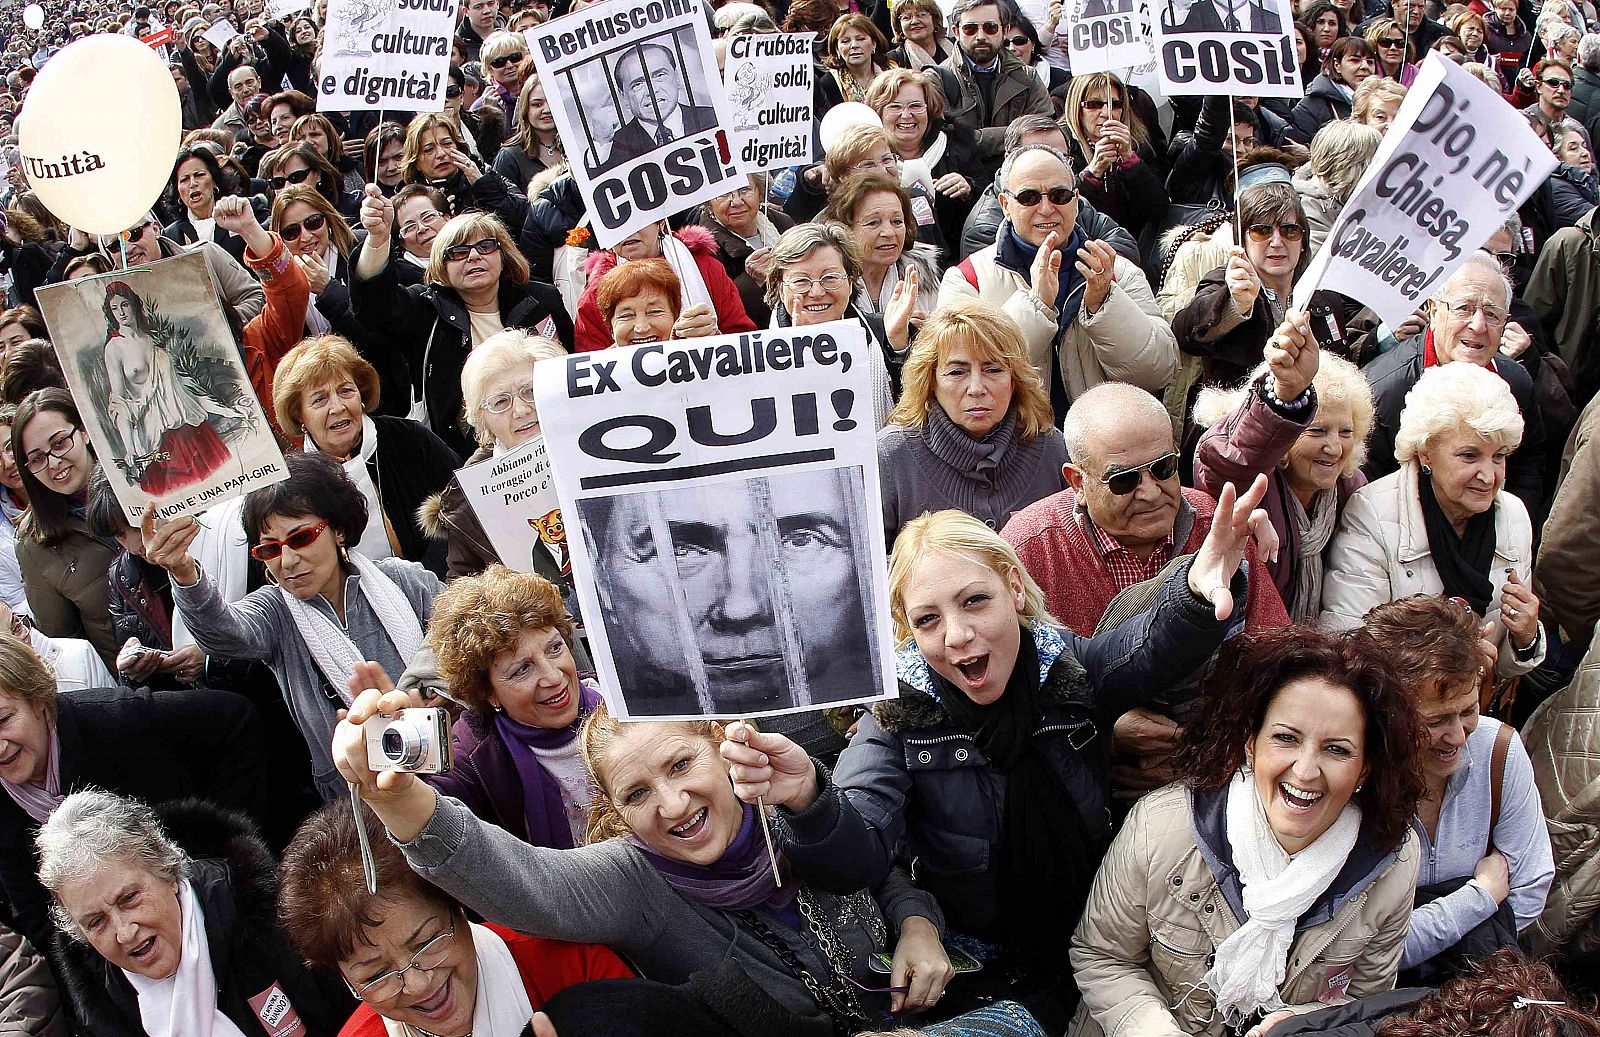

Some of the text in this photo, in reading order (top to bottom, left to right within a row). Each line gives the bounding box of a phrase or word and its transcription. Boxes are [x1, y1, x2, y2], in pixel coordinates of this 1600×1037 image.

[371, 27, 448, 56] cultura
[731, 35, 810, 58] Ci rubba:
[322, 68, 441, 104] e dignità!
[774, 64, 811, 90] soldi,
[758, 102, 810, 125] cultura
[1411, 82, 1476, 174] Dio,
[23, 151, 105, 179] l'Unità
[742, 135, 807, 167] dignità!
[1376, 151, 1469, 261] Chiesa,
[1331, 209, 1444, 300] Cavaliere!
[566, 332, 852, 398] Ex Cavaliere,
[578, 388, 858, 464] QUI!
[480, 485, 489, 496] Il
[491, 470, 532, 493] coraggio
[534, 461, 544, 474] di
[490, 453, 533, 478] Abbiamo
[128, 505, 161, 520] L'ITA
[162, 501, 186, 518] NON
[186, 496, 197, 507] E'
[199, 486, 224, 501] UNA
[224, 465, 280, 490] PAPI-GIRL
[503, 485, 538, 506] Porco
